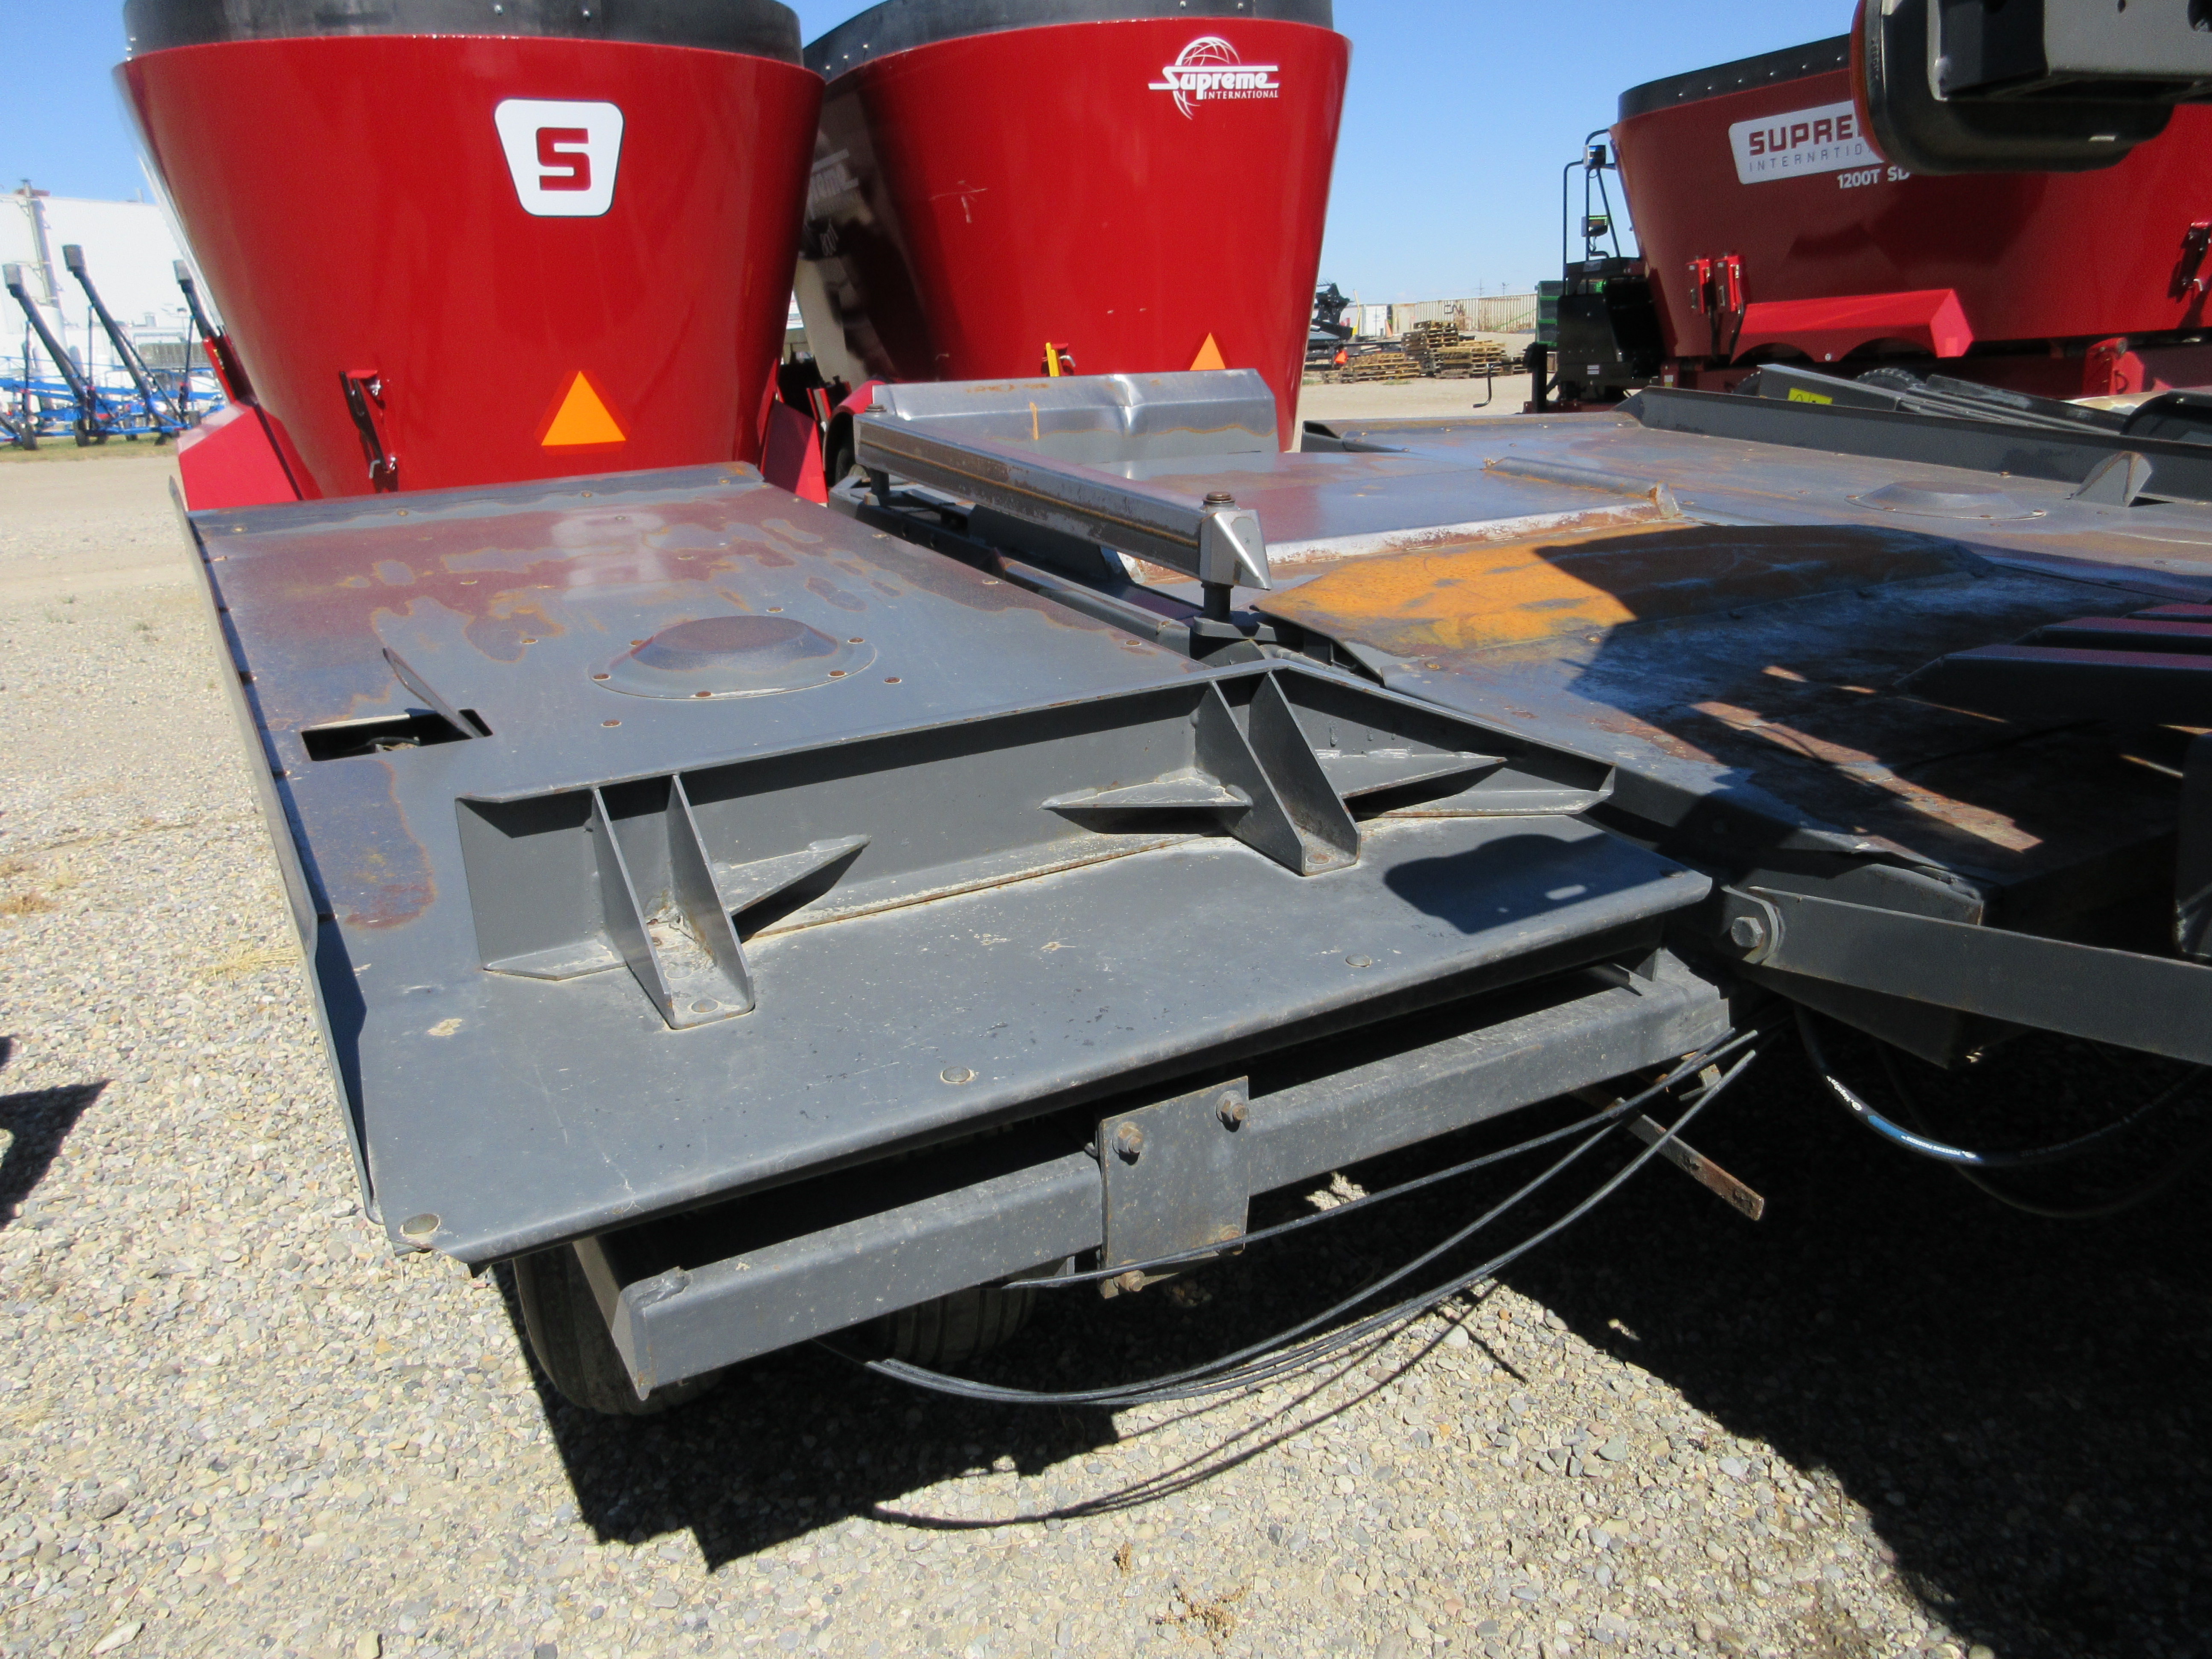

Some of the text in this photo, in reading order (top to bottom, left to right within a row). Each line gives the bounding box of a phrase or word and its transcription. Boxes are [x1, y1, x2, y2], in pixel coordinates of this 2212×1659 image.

[1148, 65, 1279, 99] Supreme
[1204, 90, 1278, 99] INTERNATIONAL
[1749, 114, 1862, 156] SUPRE
[536, 127, 591, 191] S
[1750, 143, 1871, 172] INTERNATIO
[1837, 169, 1881, 189] 1200T
[1933, 1146, 1961, 1155] POWERING
